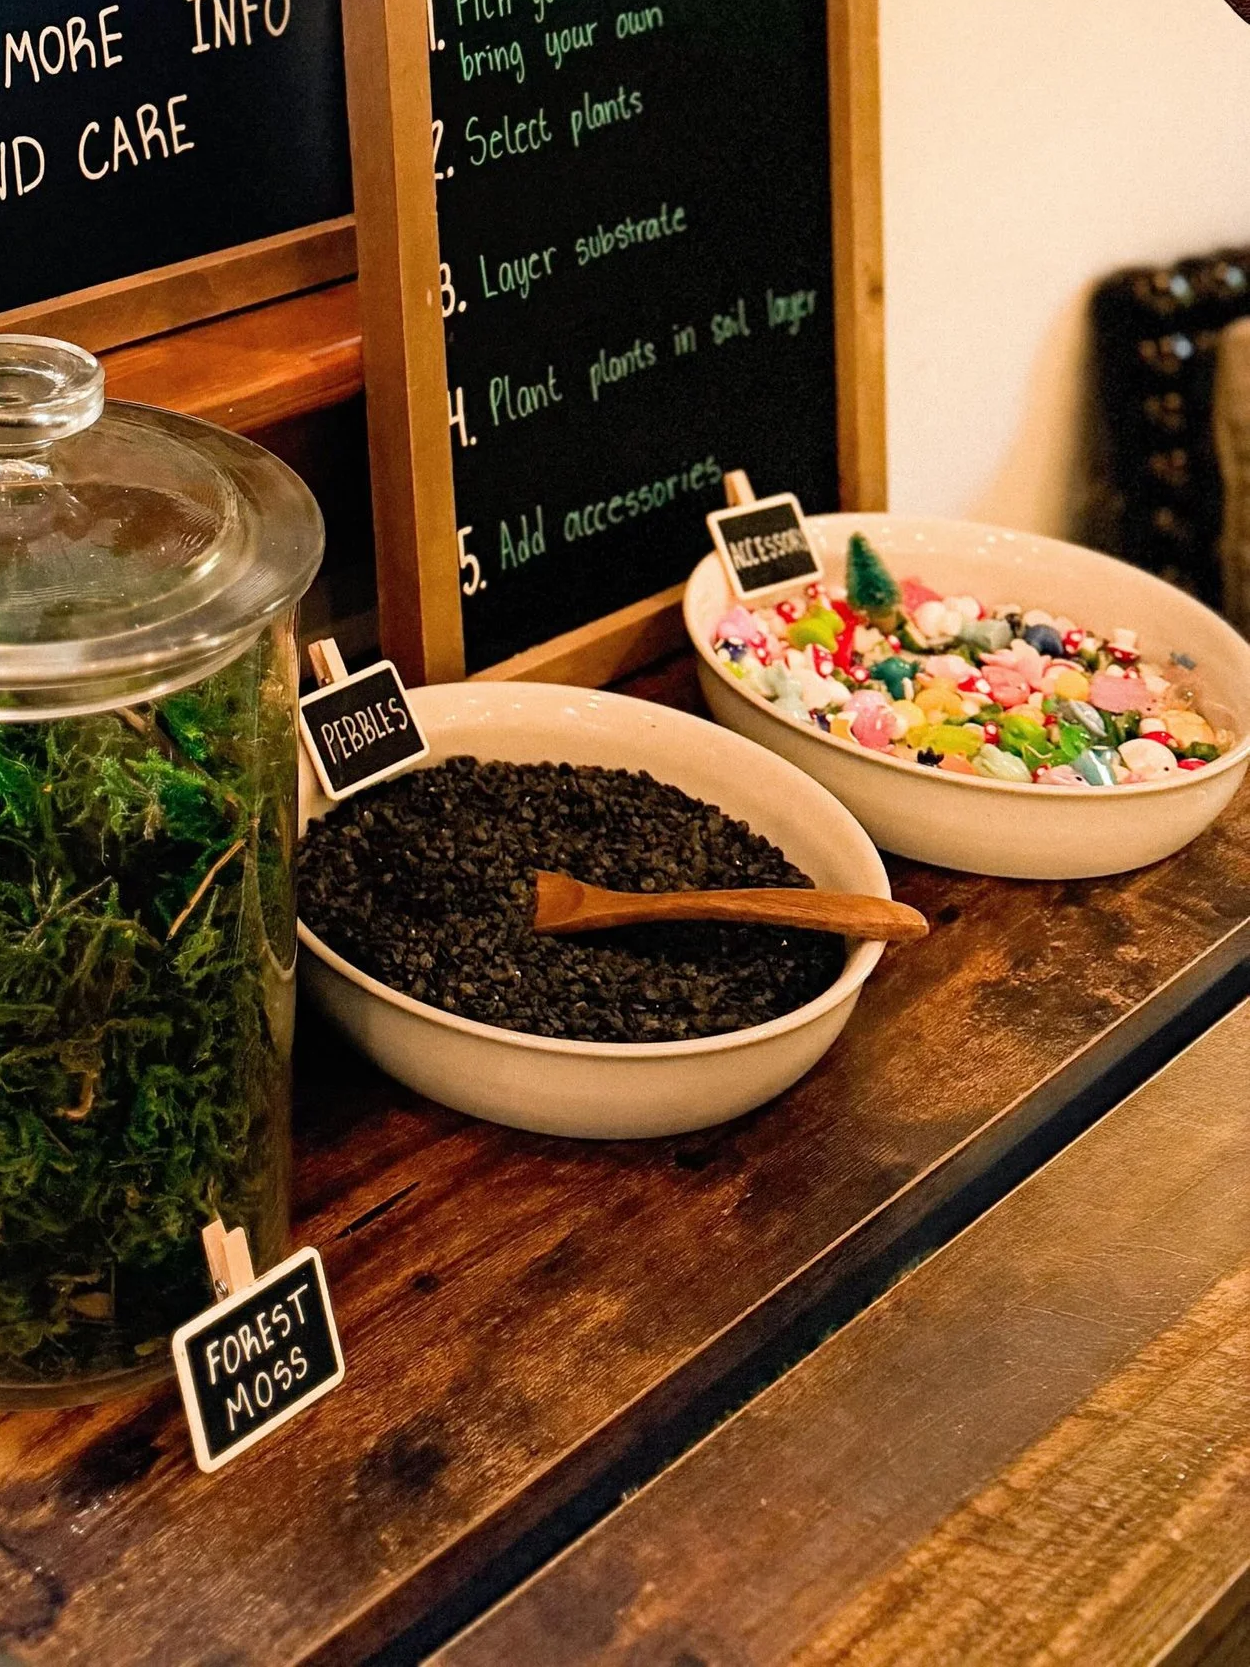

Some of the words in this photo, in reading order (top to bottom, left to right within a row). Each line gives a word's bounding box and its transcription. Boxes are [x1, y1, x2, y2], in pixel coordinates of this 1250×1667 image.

[4, 4, 124, 89] MORE
[458, 41, 526, 84] bring
[545, 19, 598, 71] your
[616, 3, 664, 40] own
[78, 94, 195, 180] CARE
[465, 109, 552, 166] Select
[570, 85, 643, 148] plants
[479, 245, 557, 300] Layer
[575, 202, 688, 267] substrate
[489, 364, 563, 427] Plant
[589, 337, 657, 402] plants
[672, 323, 697, 358] in
[711, 298, 751, 346] soil
[767, 287, 817, 336] layer
[498, 505, 546, 571] Add
[562, 454, 724, 542] accessories
[320, 697, 408, 765] PEBBLES
[206, 1283, 309, 1385] FOREST
[226, 1346, 308, 1432] MOSS
